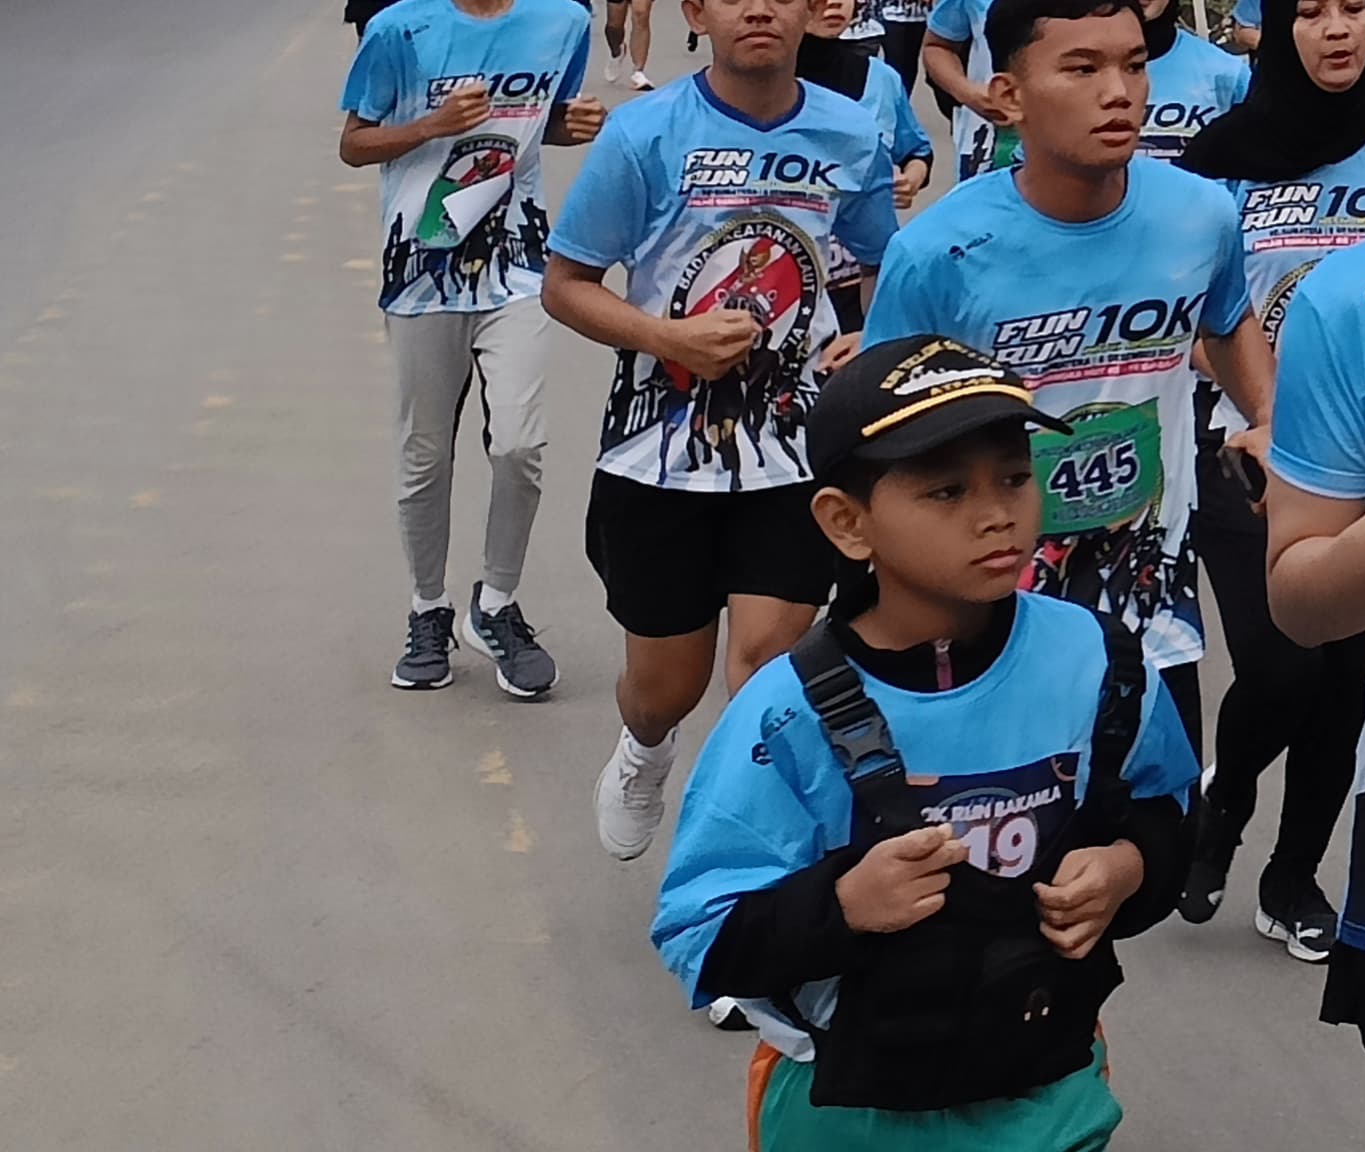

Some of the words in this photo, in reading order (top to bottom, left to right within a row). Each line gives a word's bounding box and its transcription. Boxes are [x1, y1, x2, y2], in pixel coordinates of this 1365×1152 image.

[488, 71, 559, 98] 10K
[684, 148, 754, 173] FUN
[760, 153, 841, 189] 10K
[1244, 183, 1323, 210] FUN
[1241, 205, 1317, 232] RUN
[994, 307, 1091, 345] FUN
[1096, 291, 1208, 347] 10K
[994, 334, 1085, 367] RUN
[1047, 438, 1140, 502] 445
[950, 803, 991, 821] RUN
[960, 816, 1036, 878] 19
